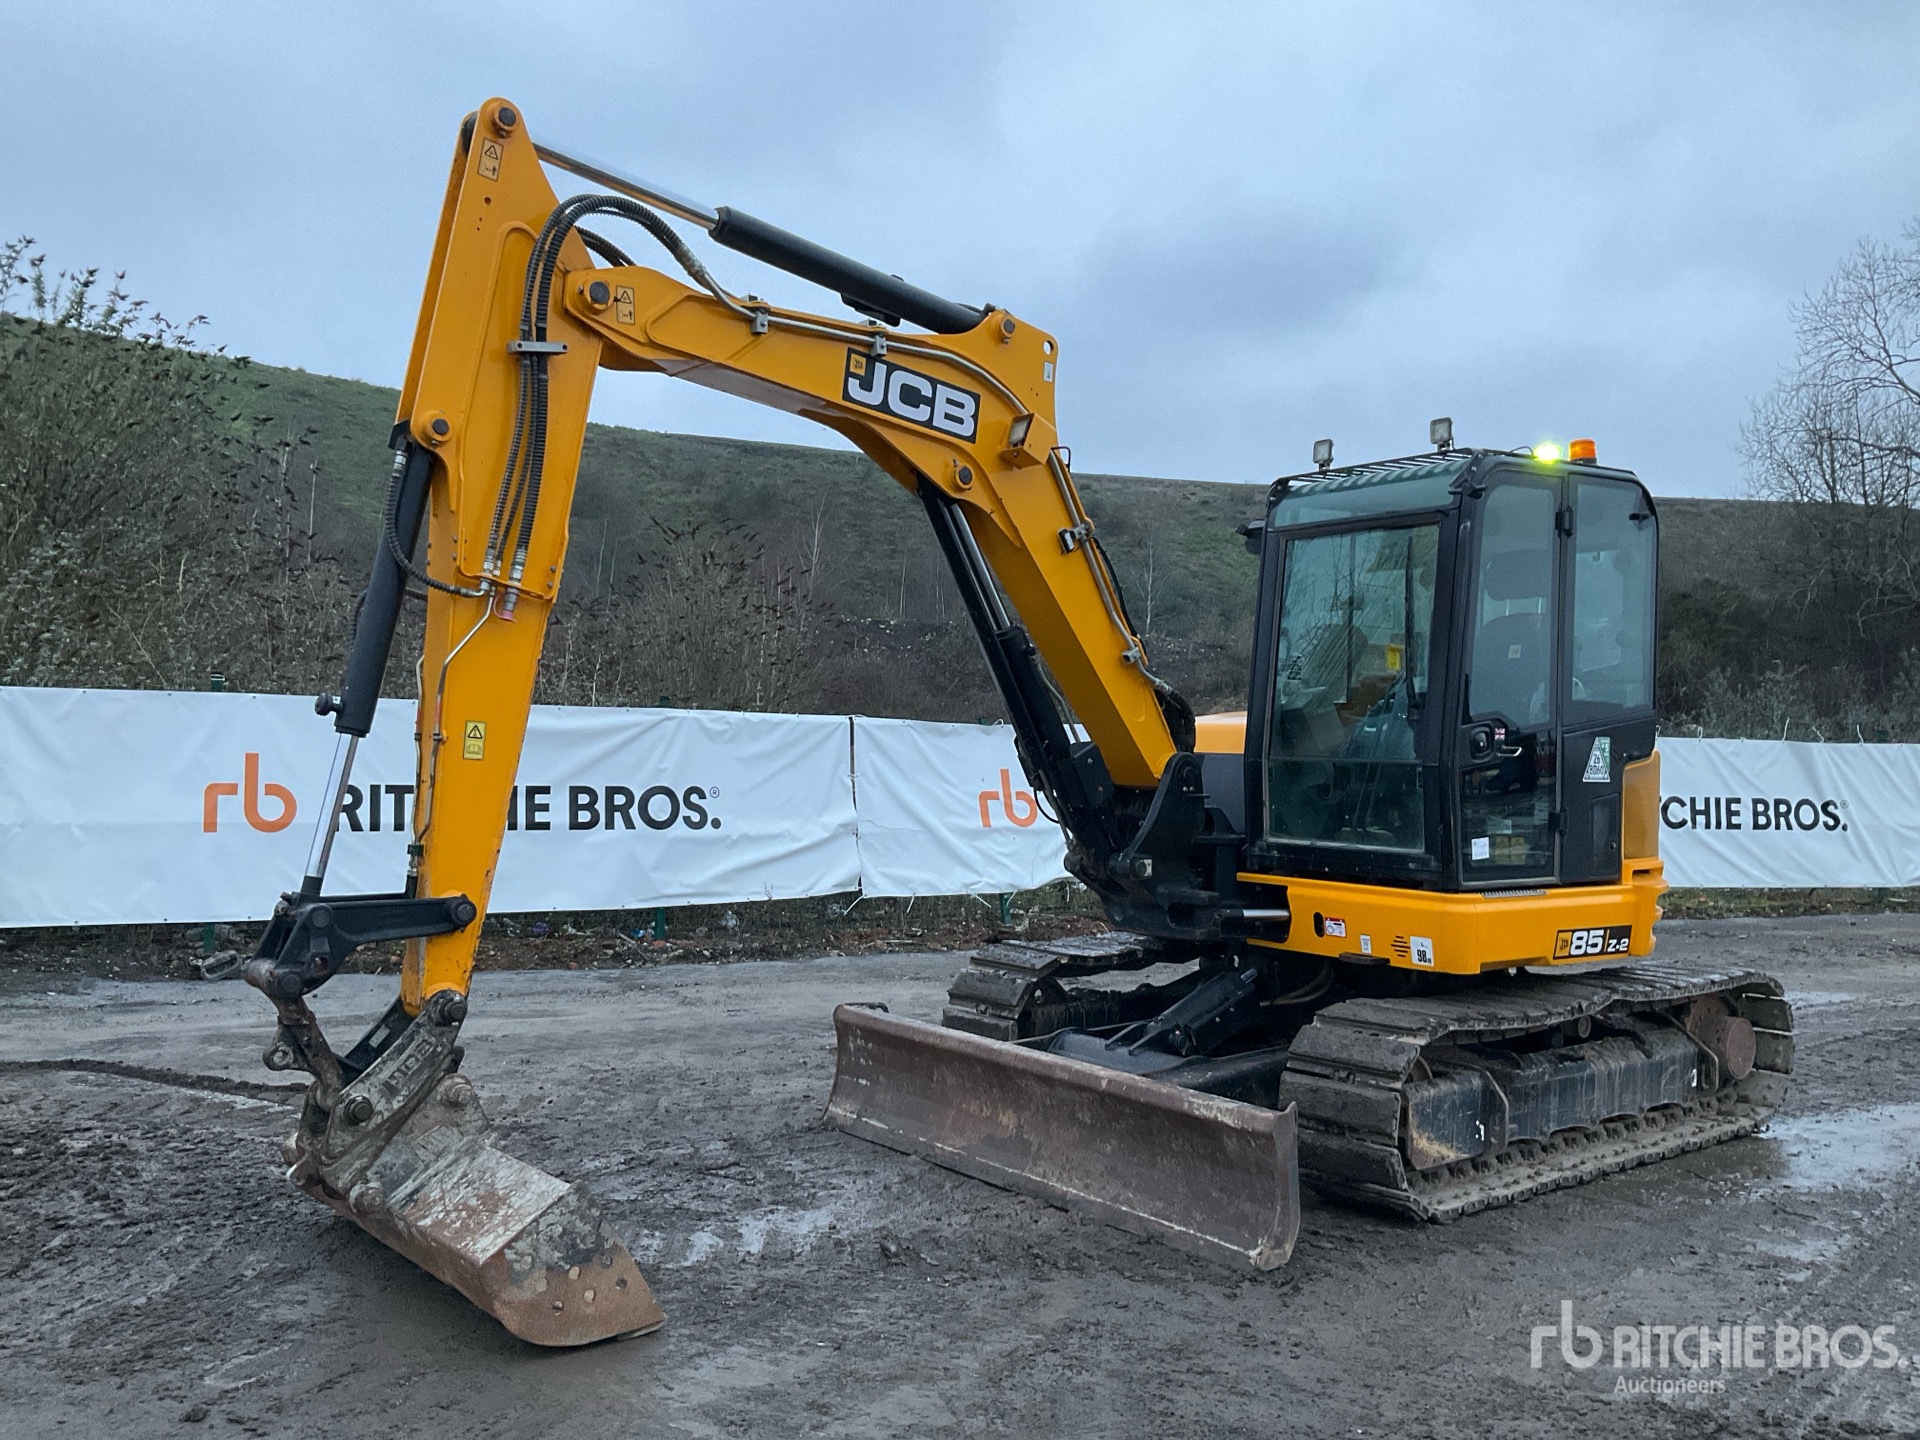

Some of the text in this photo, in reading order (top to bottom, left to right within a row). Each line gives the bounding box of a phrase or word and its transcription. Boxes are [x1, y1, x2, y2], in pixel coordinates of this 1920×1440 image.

[847, 361, 976, 437] JCB
[336, 784, 552, 832] RITIE
[1660, 795, 1742, 830] CHIE
[1416, 949, 1428, 963] 98
[1570, 928, 1605, 956] 85
